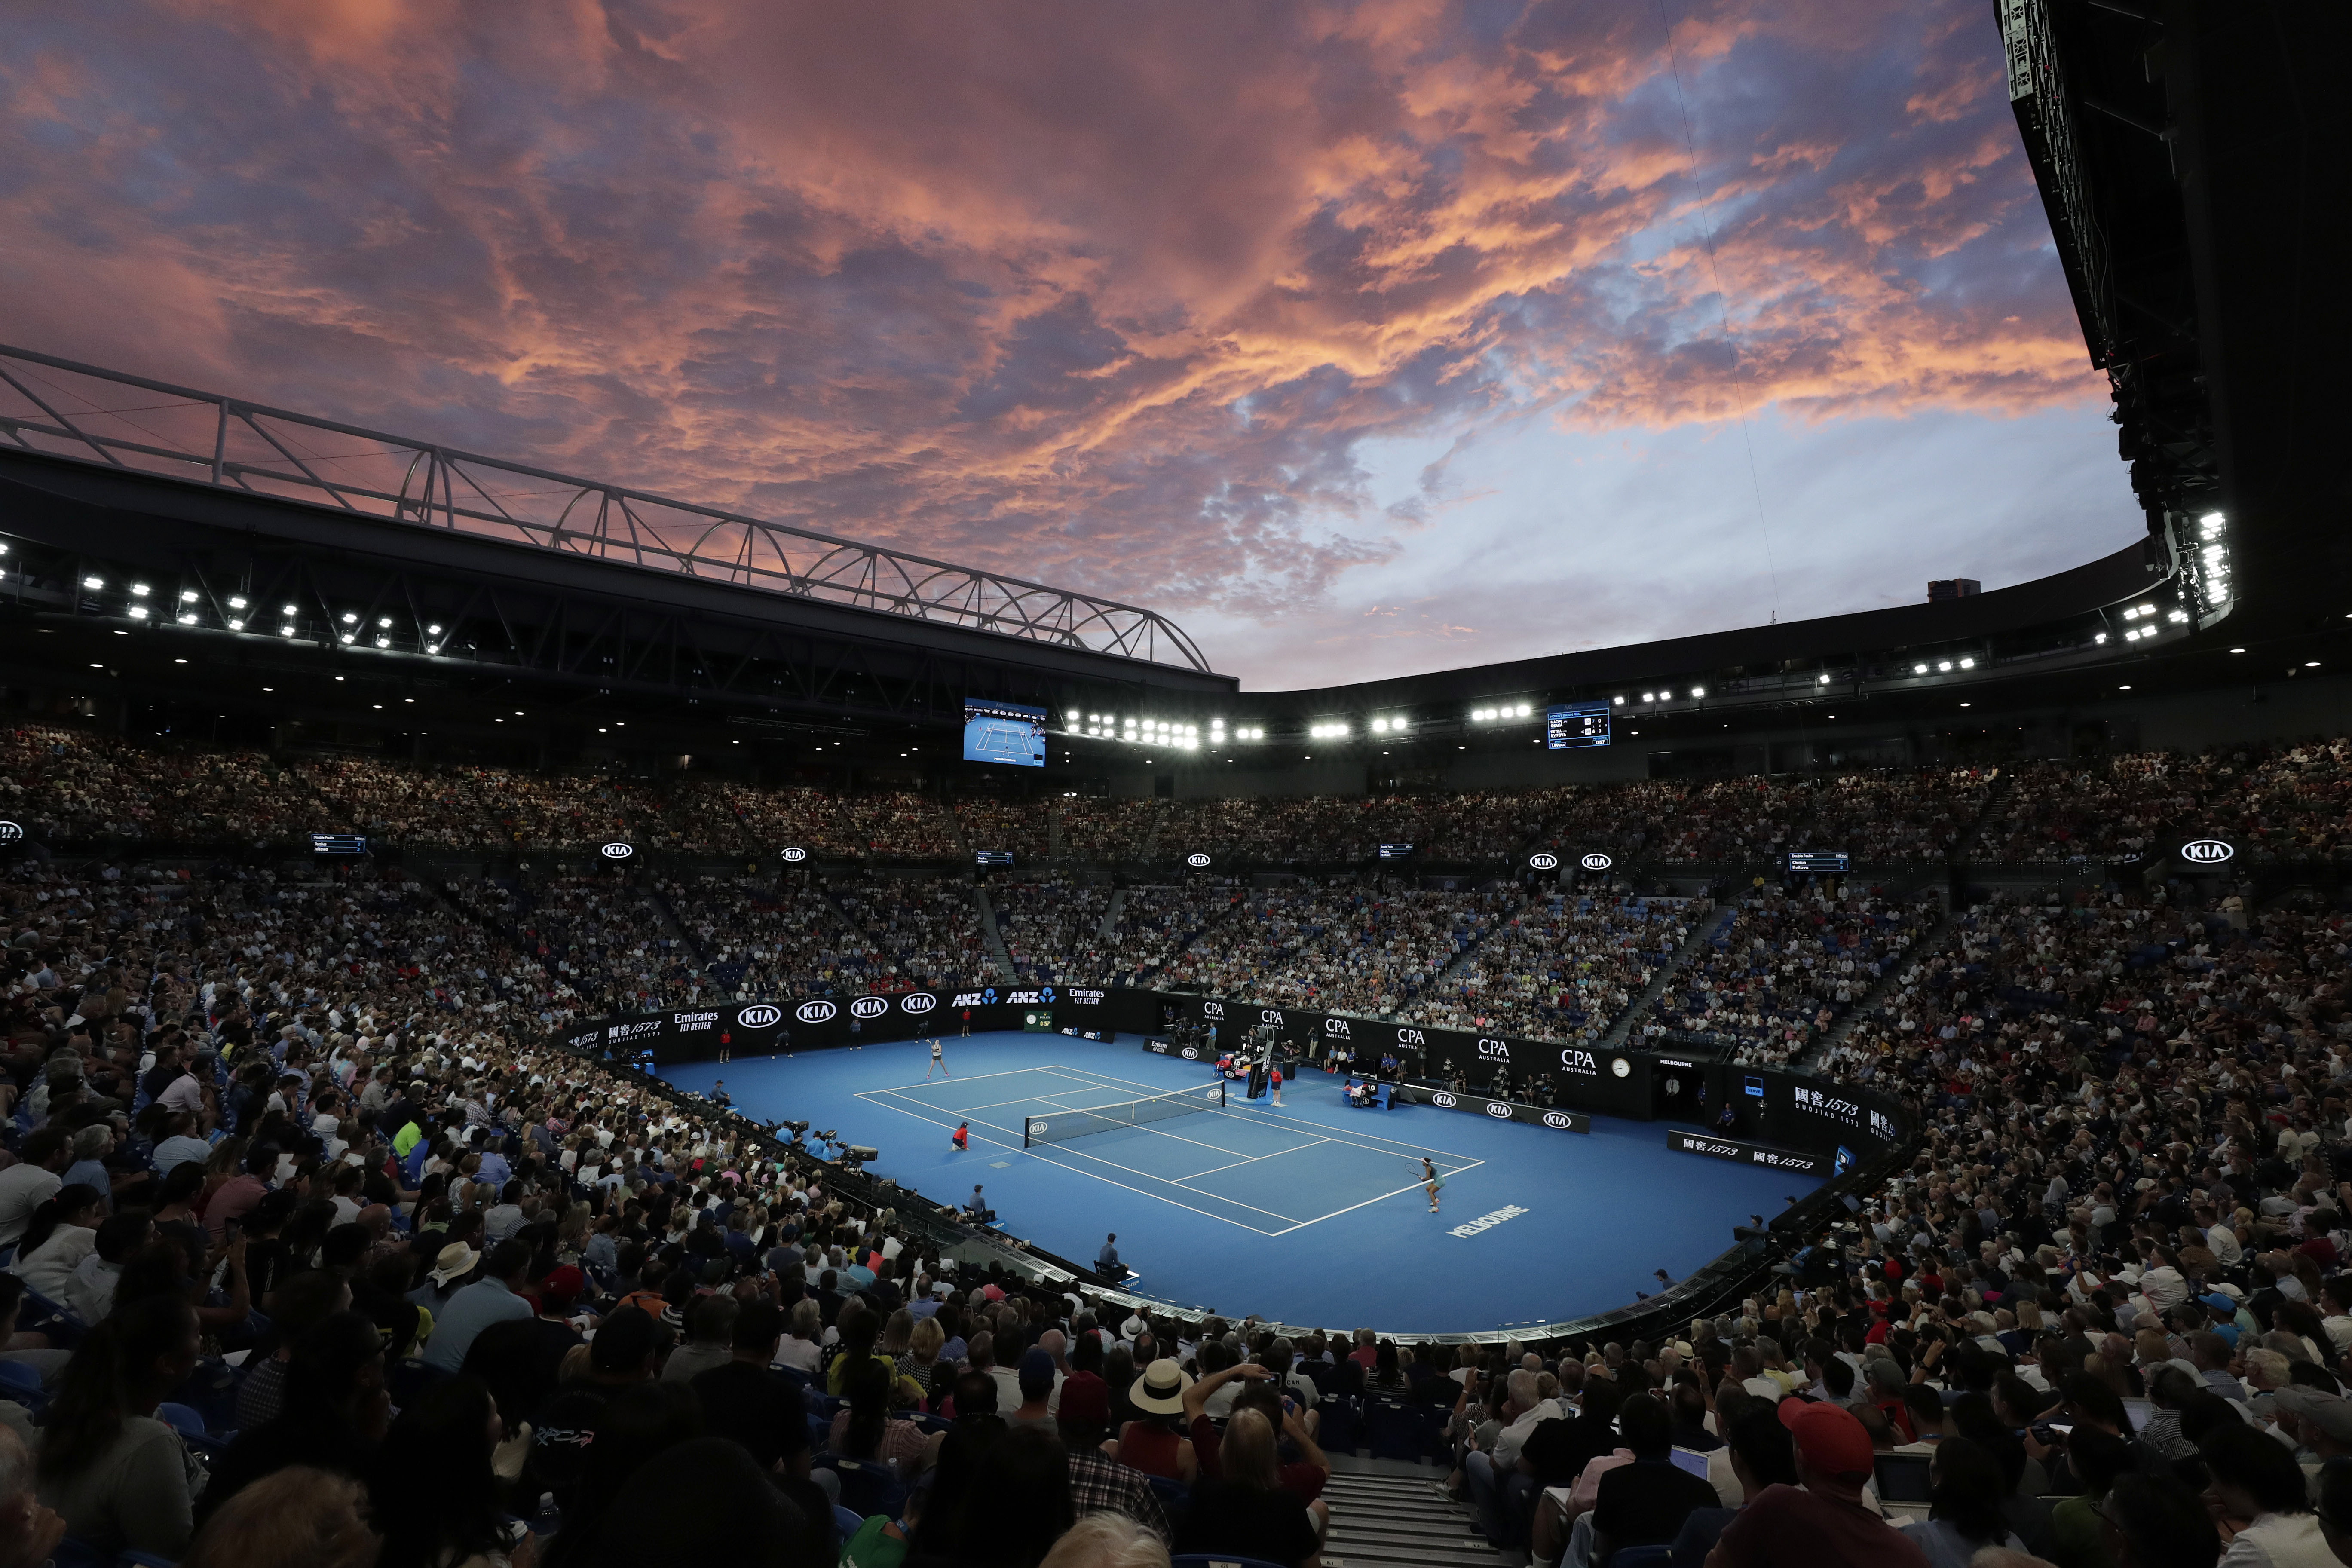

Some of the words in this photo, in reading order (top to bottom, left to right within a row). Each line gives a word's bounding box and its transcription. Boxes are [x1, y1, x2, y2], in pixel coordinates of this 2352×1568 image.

[607, 846, 627, 854] KIA
[2190, 845, 2225, 858] KIA
[1534, 857, 1553, 866] KIA
[1586, 857, 1606, 866] KIA
[1006, 991, 1038, 1004] ANZ
[1069, 989, 1104, 998] Emirates
[907, 997, 930, 1009] KIA
[951, 993, 981, 1007] ANZ
[803, 1005, 830, 1019] KIA
[857, 1001, 882, 1014] KIA
[1204, 1002, 1224, 1016] CPA
[674, 1011, 718, 1023] Emirates
[746, 1010, 773, 1023] KIA
[1262, 1010, 1283, 1024] CPA
[680, 1023, 690, 1032] FLY
[690, 1021, 711, 1031] BETTER
[1326, 1019, 1350, 1034] CPA
[609, 1035, 638, 1044] GUOJIAO
[1083, 1032, 1095, 1040] ANZ
[1398, 1028, 1425, 1045] CPA
[1152, 1041, 1168, 1049] Emirates
[1479, 1039, 1510, 1057] CPA
[1184, 1049, 1195, 1057] KIA
[1479, 1055, 1510, 1063] AUSTRALIA
[1562, 1049, 1596, 1069] CPA
[1660, 1060, 1692, 1068] MELBOURNE
[1562, 1066, 1596, 1075] AUSTRALIA
[1436, 1096, 1452, 1105] KIA
[1491, 1105, 1507, 1115] KIA
[1795, 1102, 1834, 1118] GUOJIAO
[1841, 1116, 1859, 1127] 1573
[1548, 1115, 1566, 1126] KIA
[1032, 1124, 1044, 1133] KIA
[1446, 1204, 1530, 1239] MELBOURNE
